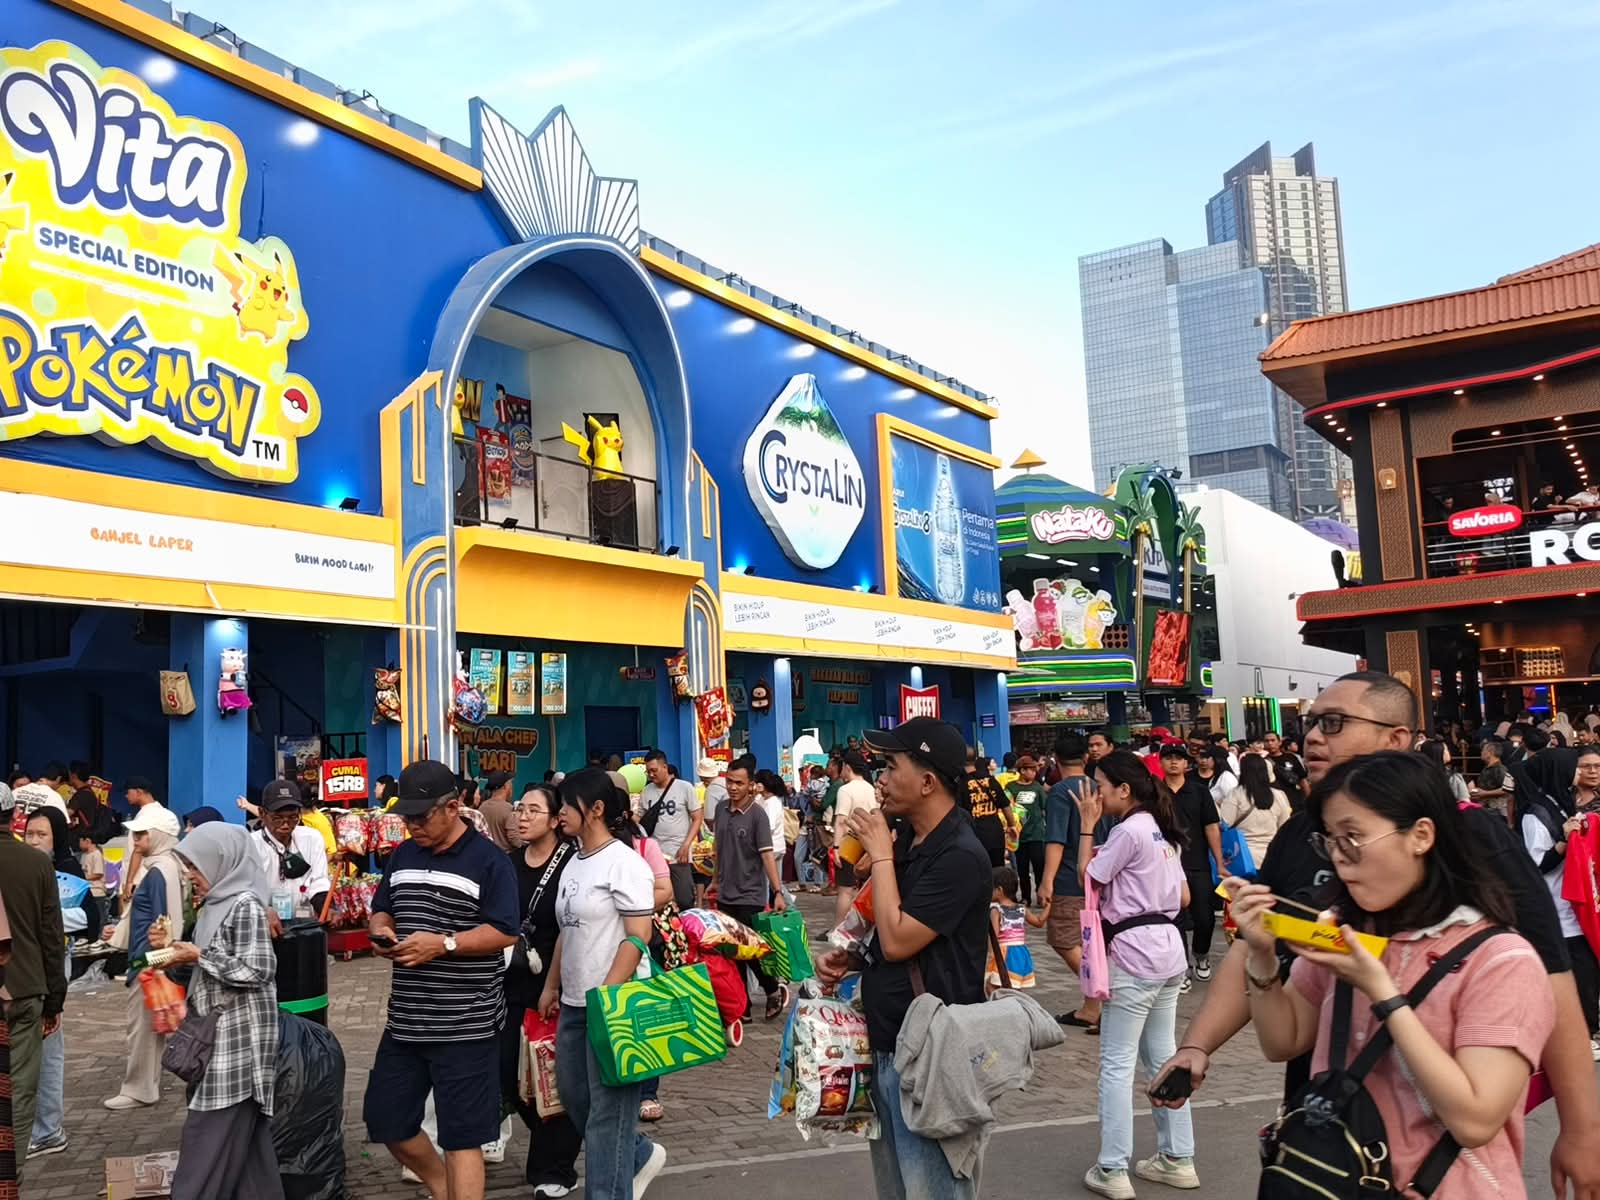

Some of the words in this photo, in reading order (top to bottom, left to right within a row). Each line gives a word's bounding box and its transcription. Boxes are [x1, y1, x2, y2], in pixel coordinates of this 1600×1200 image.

[1, 63, 229, 226] Vita
[39, 227, 128, 268] SPECIAL
[134, 257, 214, 292] EDITION
[252, 439, 281, 462] TM
[962, 508, 995, 529] Pertama
[1452, 511, 1515, 530] SAVORIA
[149, 534, 193, 552] LAPER
[322, 558, 348, 569] MOOD
[477, 728, 502, 744] ALA
[504, 730, 537, 745] CHEF
[331, 766, 360, 776] CUMA
[326, 775, 365, 793] 15RB
